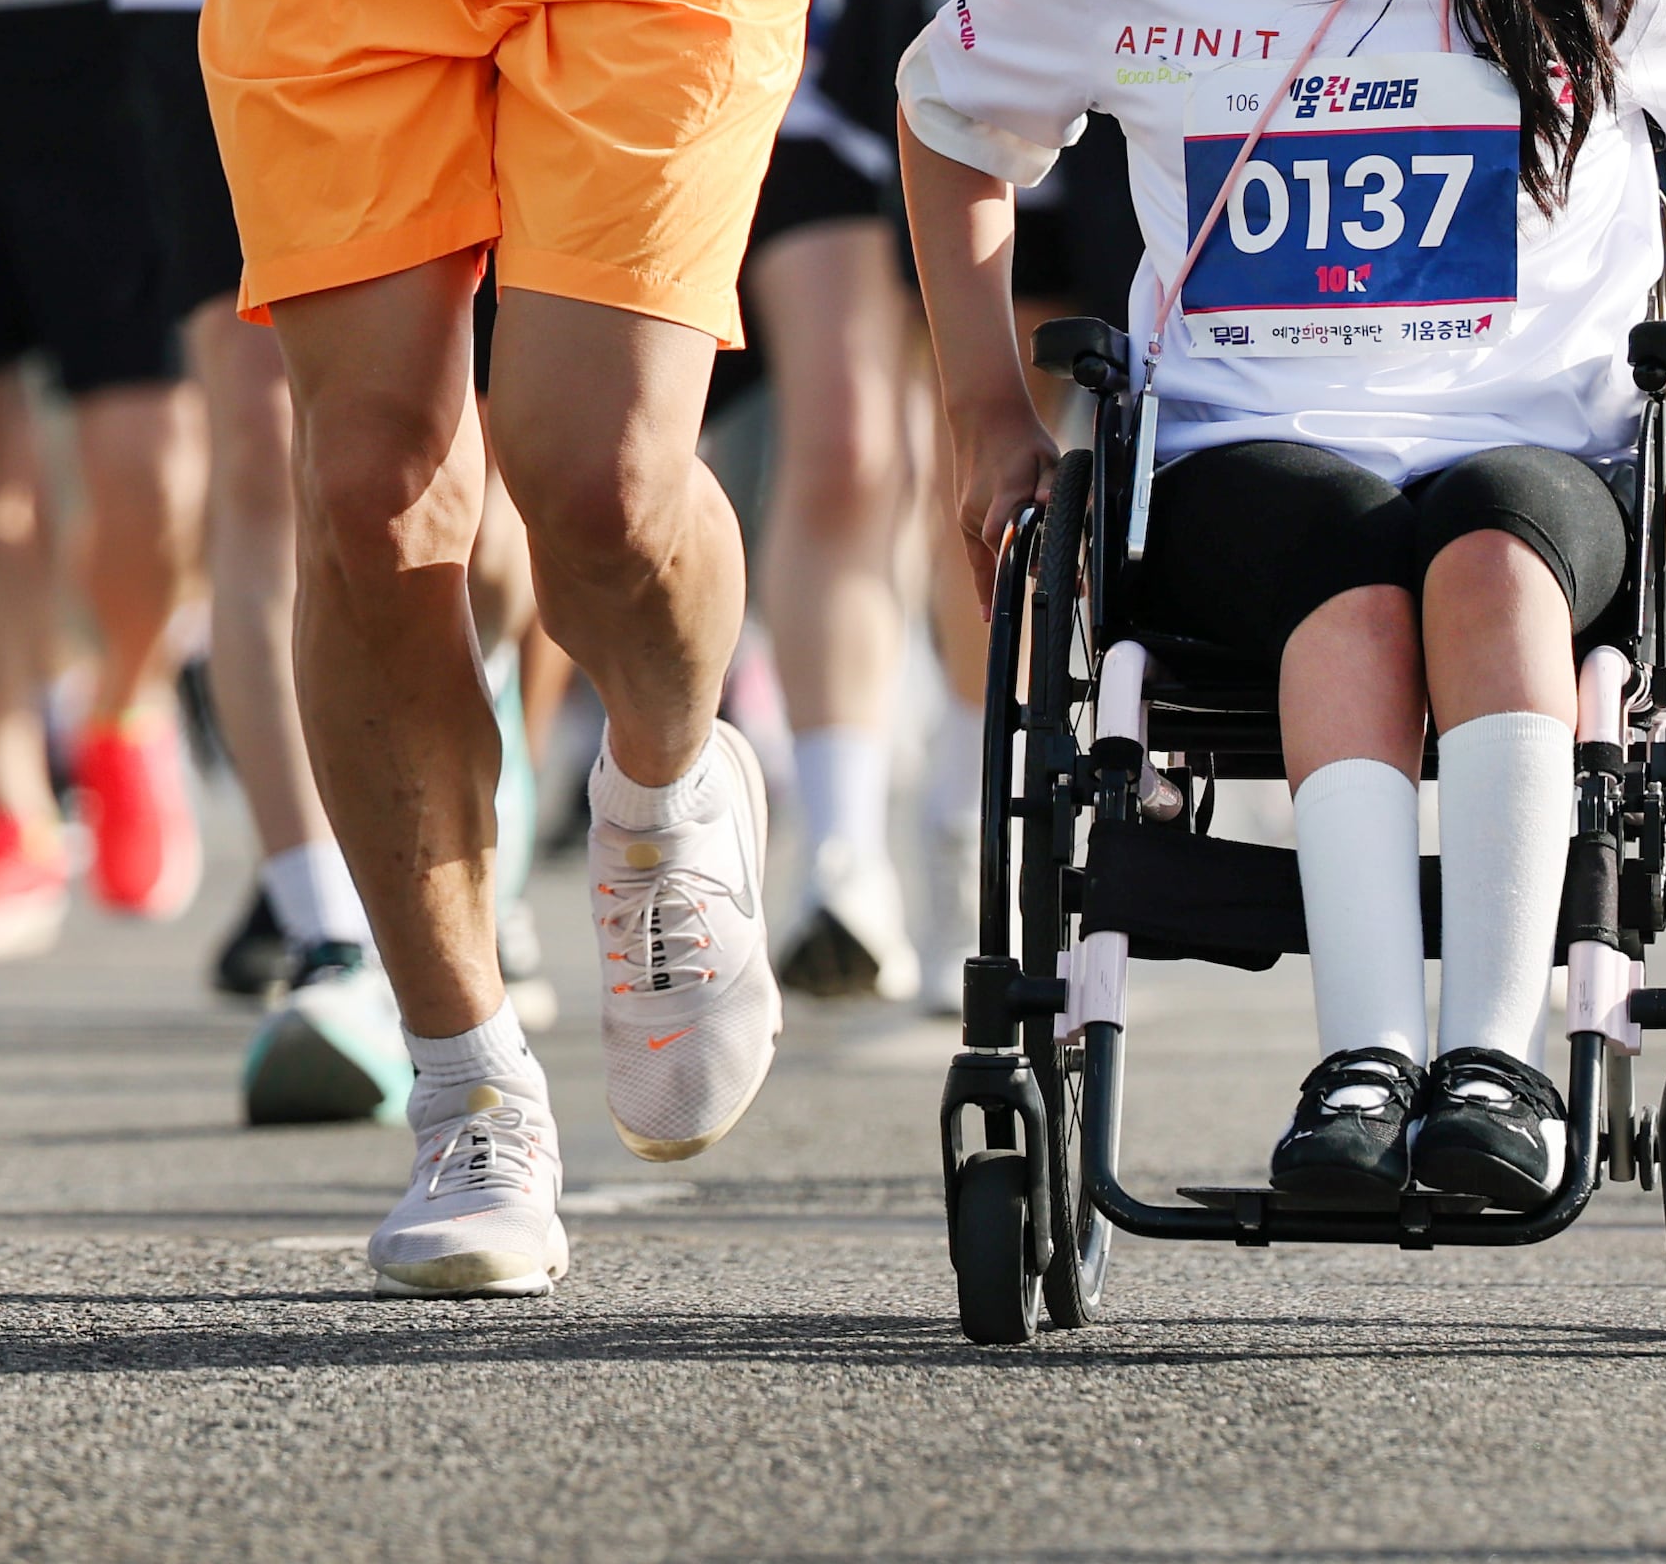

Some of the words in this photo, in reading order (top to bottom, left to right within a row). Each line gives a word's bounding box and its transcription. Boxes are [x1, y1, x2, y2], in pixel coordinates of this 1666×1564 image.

[1115, 26, 1280, 59] AFINIT
[1226, 94, 1259, 112] 106
[1349, 78, 1419, 111] 2026
[1226, 155, 1475, 254] 0137
[1272, 322, 1383, 346] 예강희망키움재단
[1400, 318, 1472, 341] 키움증권
